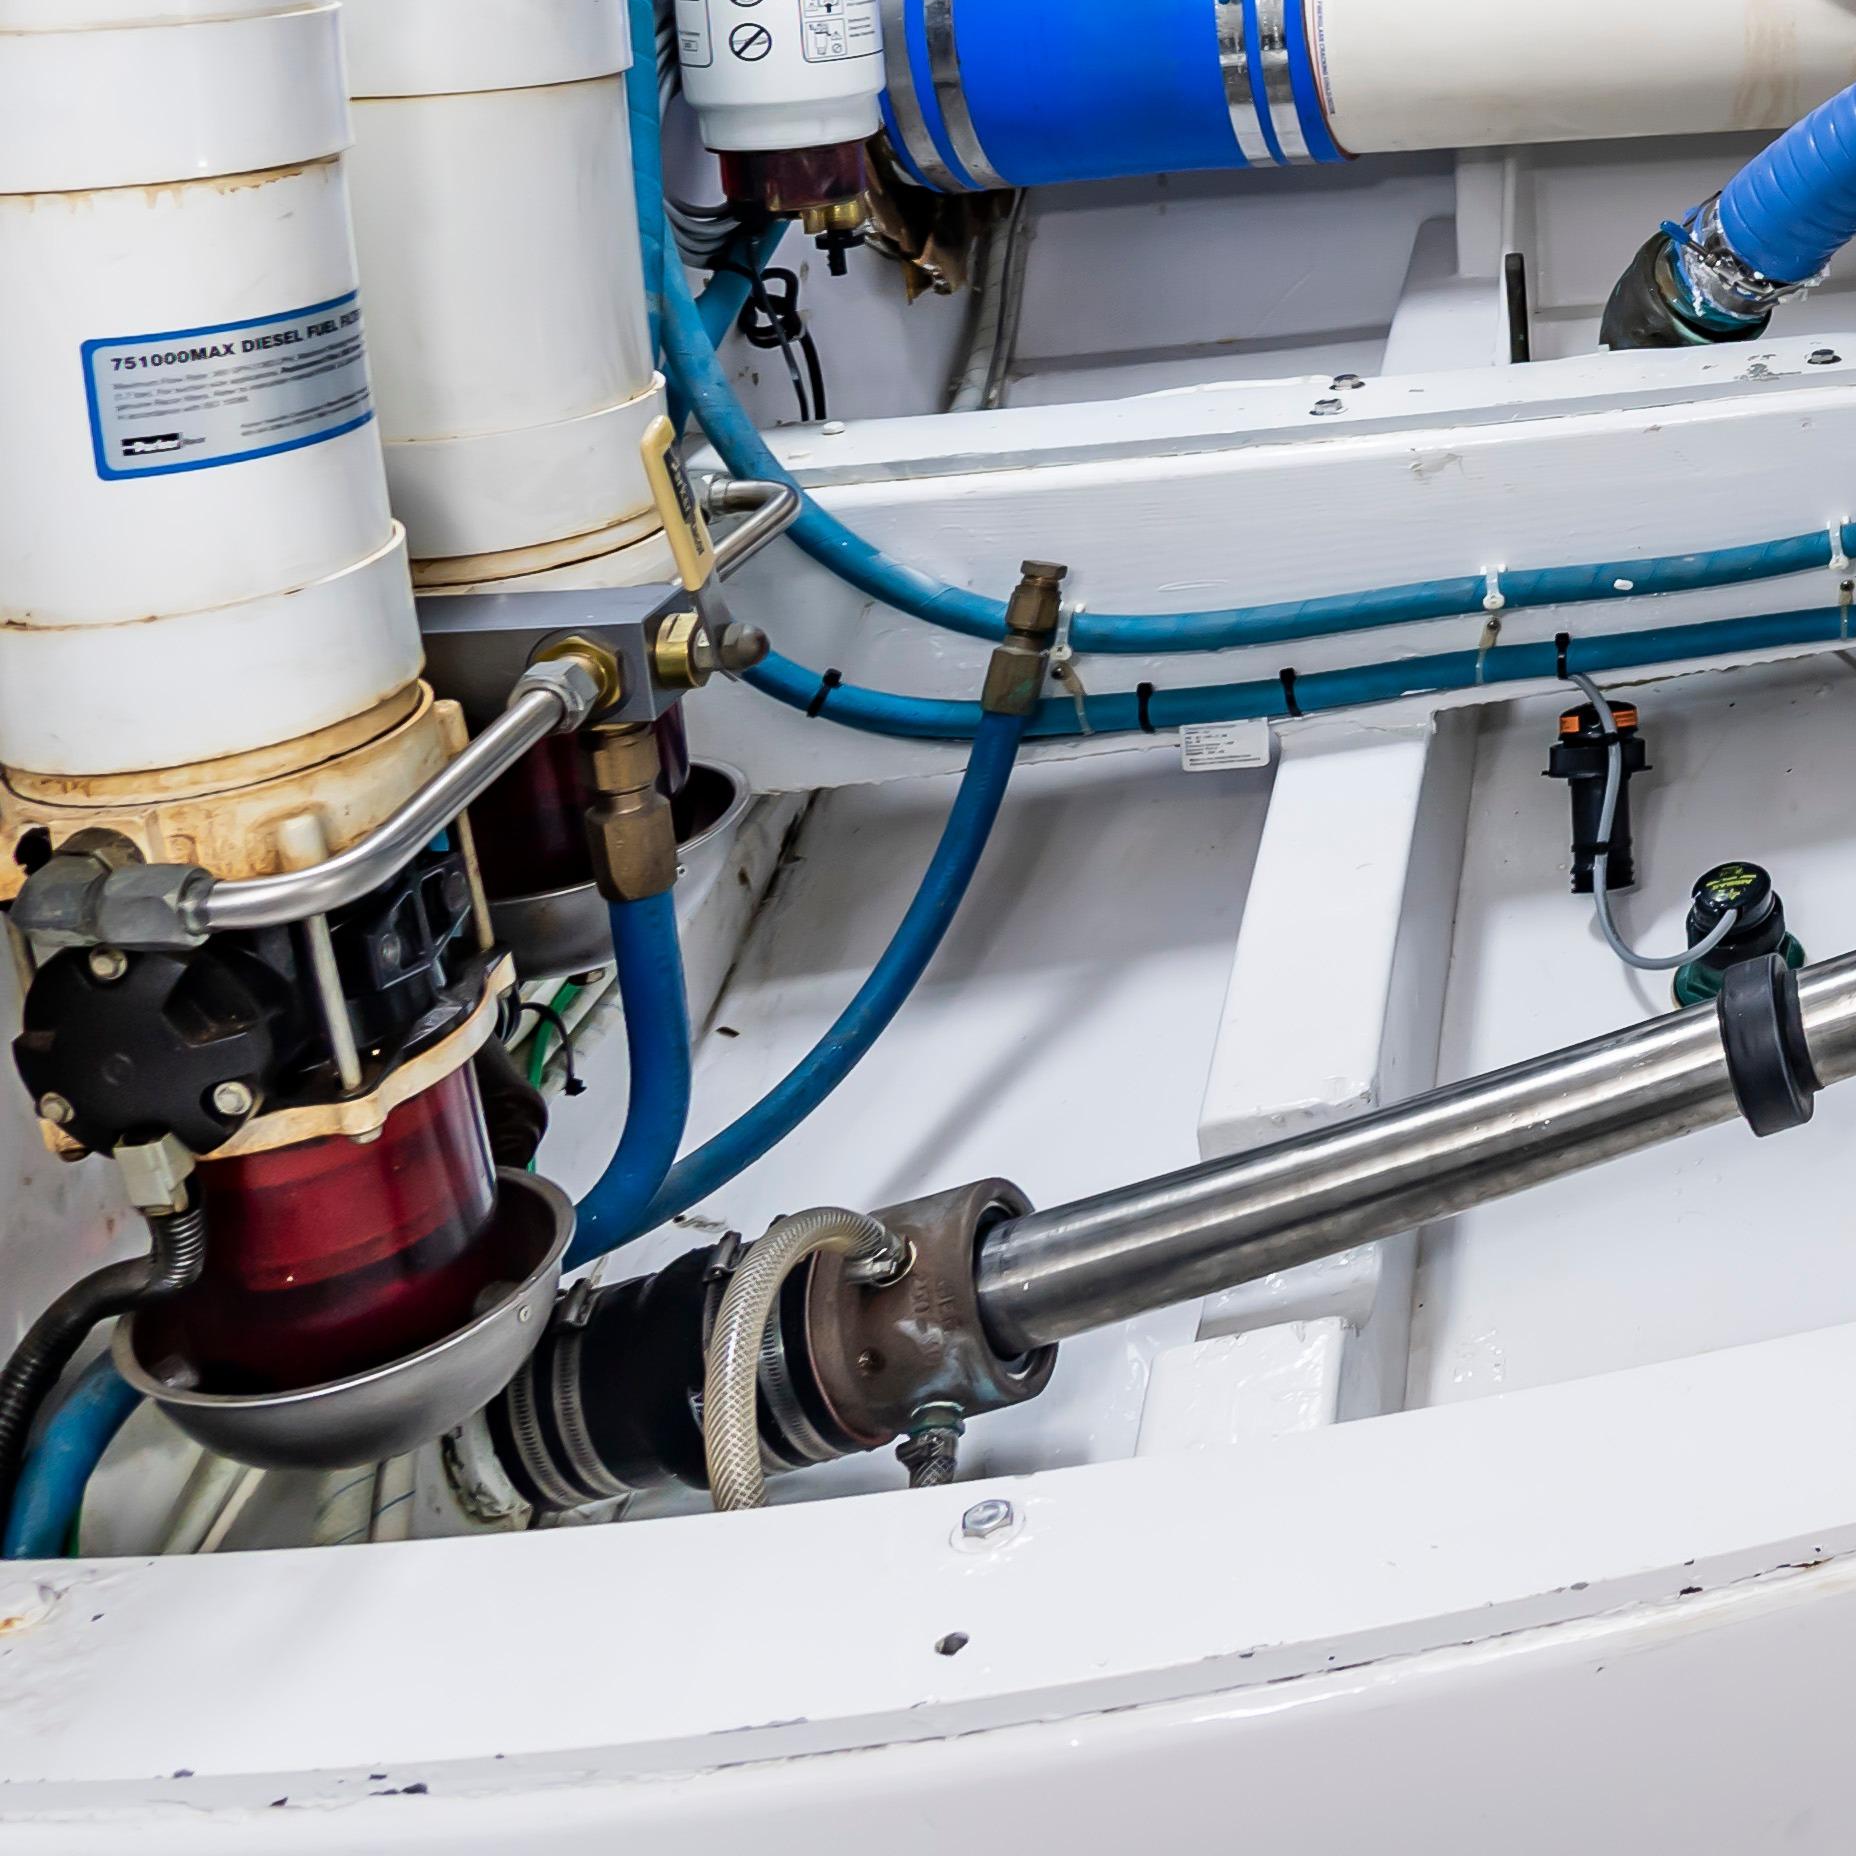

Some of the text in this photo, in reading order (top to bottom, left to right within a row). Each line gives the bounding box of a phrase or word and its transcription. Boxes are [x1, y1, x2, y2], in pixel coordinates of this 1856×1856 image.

[111, 342, 236, 371] 751000MAX
[241, 329, 304, 354] DIESEL
[306, 319, 339, 339] FUEL
